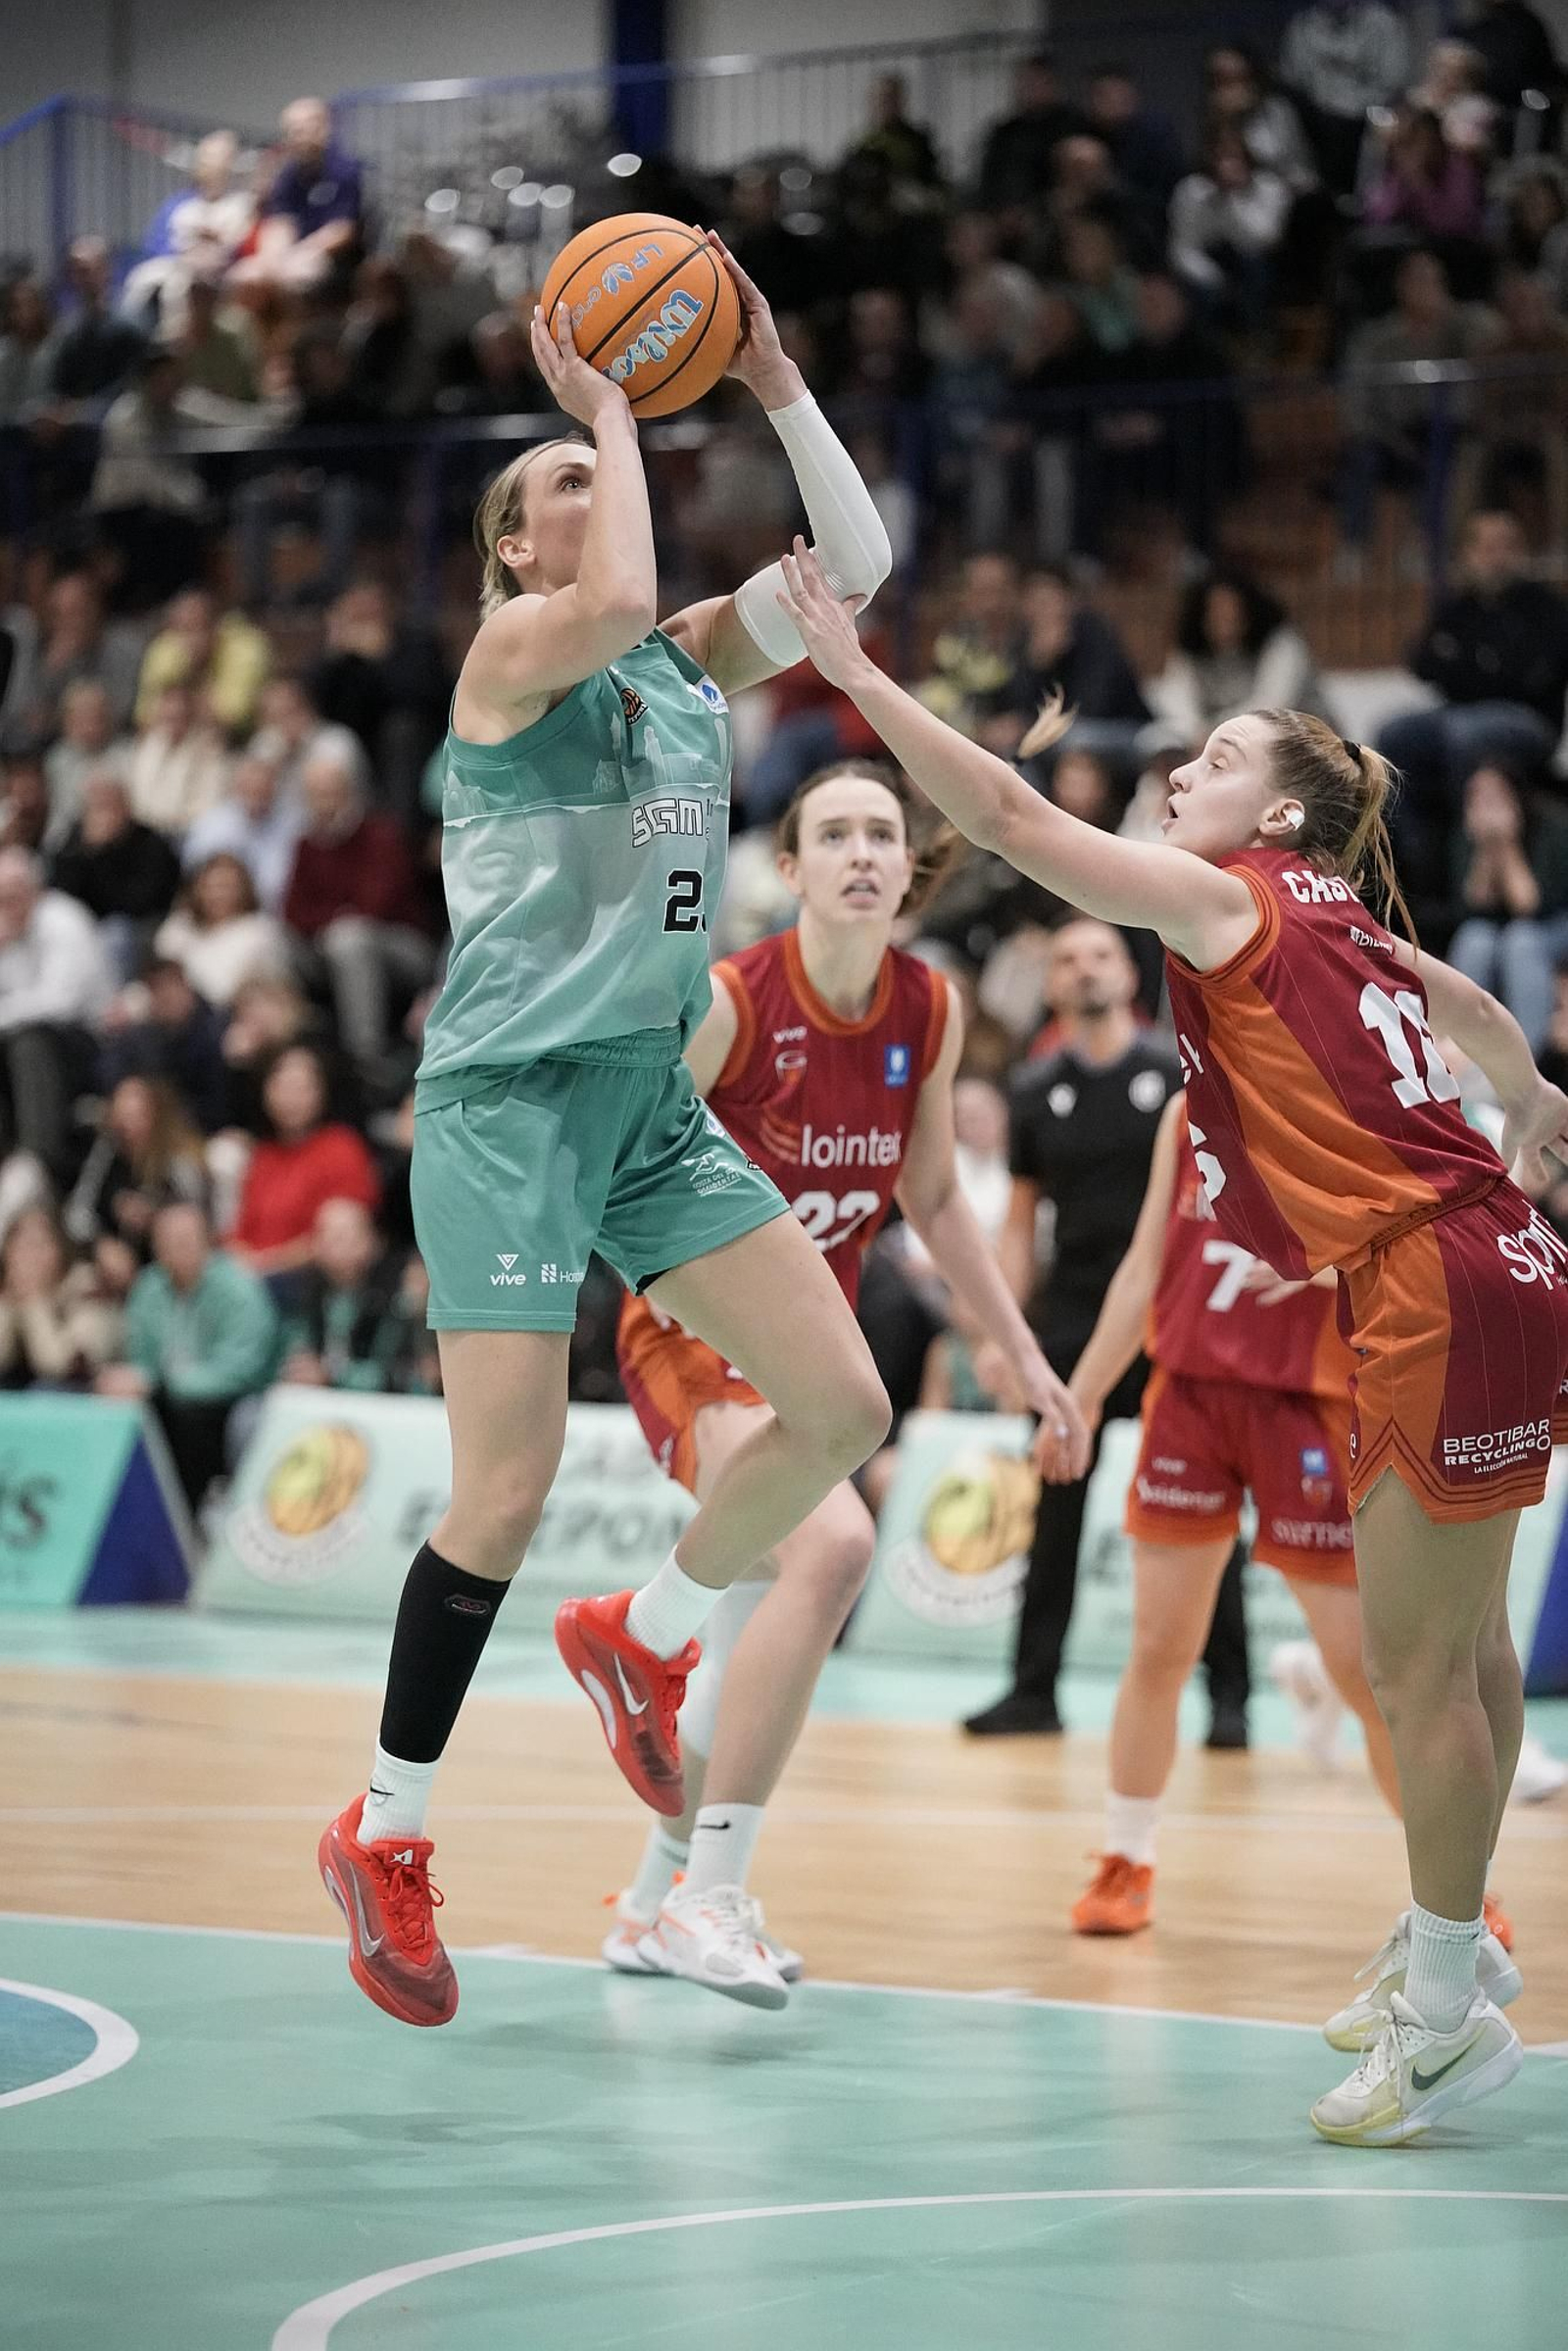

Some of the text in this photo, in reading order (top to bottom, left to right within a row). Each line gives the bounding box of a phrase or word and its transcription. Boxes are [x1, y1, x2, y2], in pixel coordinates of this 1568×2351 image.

[631, 797, 713, 849] SGM
[662, 868, 708, 934] 2
[490, 1271, 527, 1286] vive
[1201, 1240, 1256, 1312] 7
[1444, 1418, 1550, 1454] BEOTIBAR
